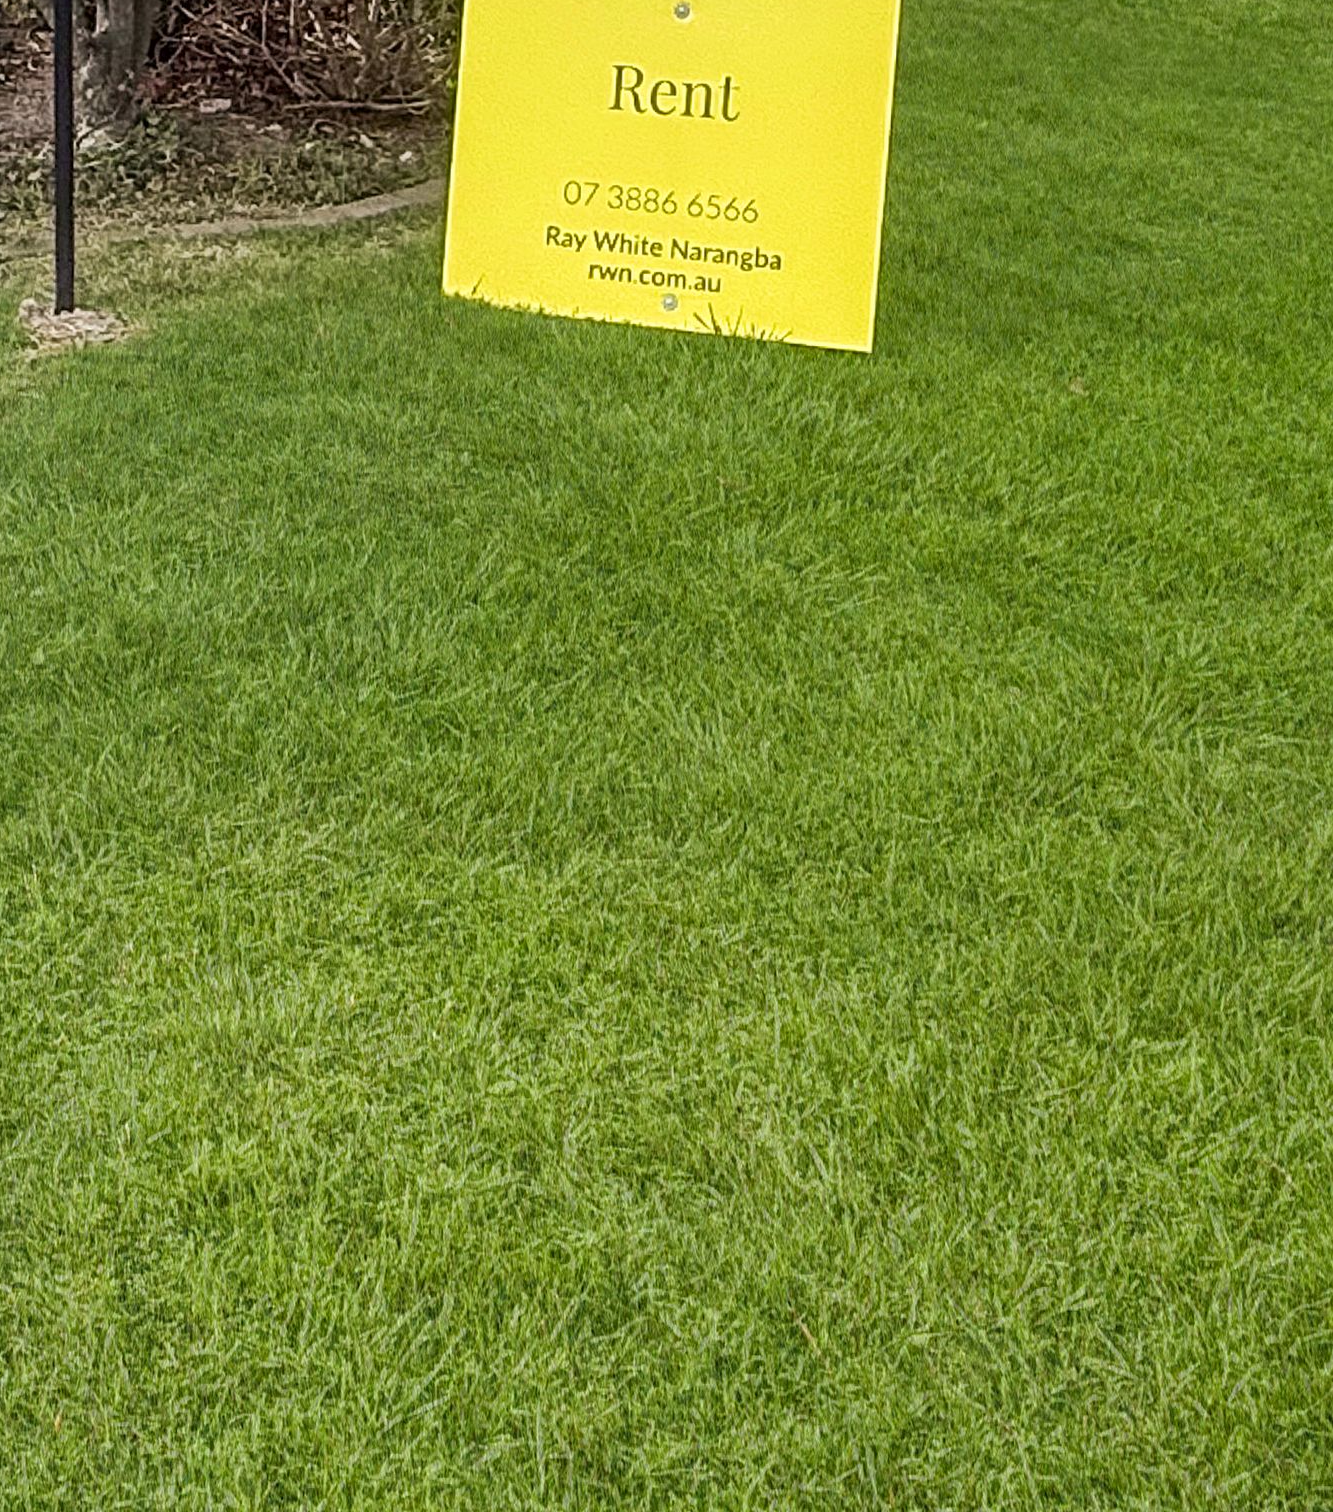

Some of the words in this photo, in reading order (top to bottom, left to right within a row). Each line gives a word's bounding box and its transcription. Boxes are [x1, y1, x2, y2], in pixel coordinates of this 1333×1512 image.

[608, 64, 741, 122] Rent
[563, 180, 600, 207] 07
[606, 184, 678, 215] 3886
[686, 192, 759, 224] 6566
[545, 225, 587, 253] Ray
[593, 230, 664, 258] White
[670, 238, 782, 272] Narangba
[587, 263, 722, 293] rwn.com.au
